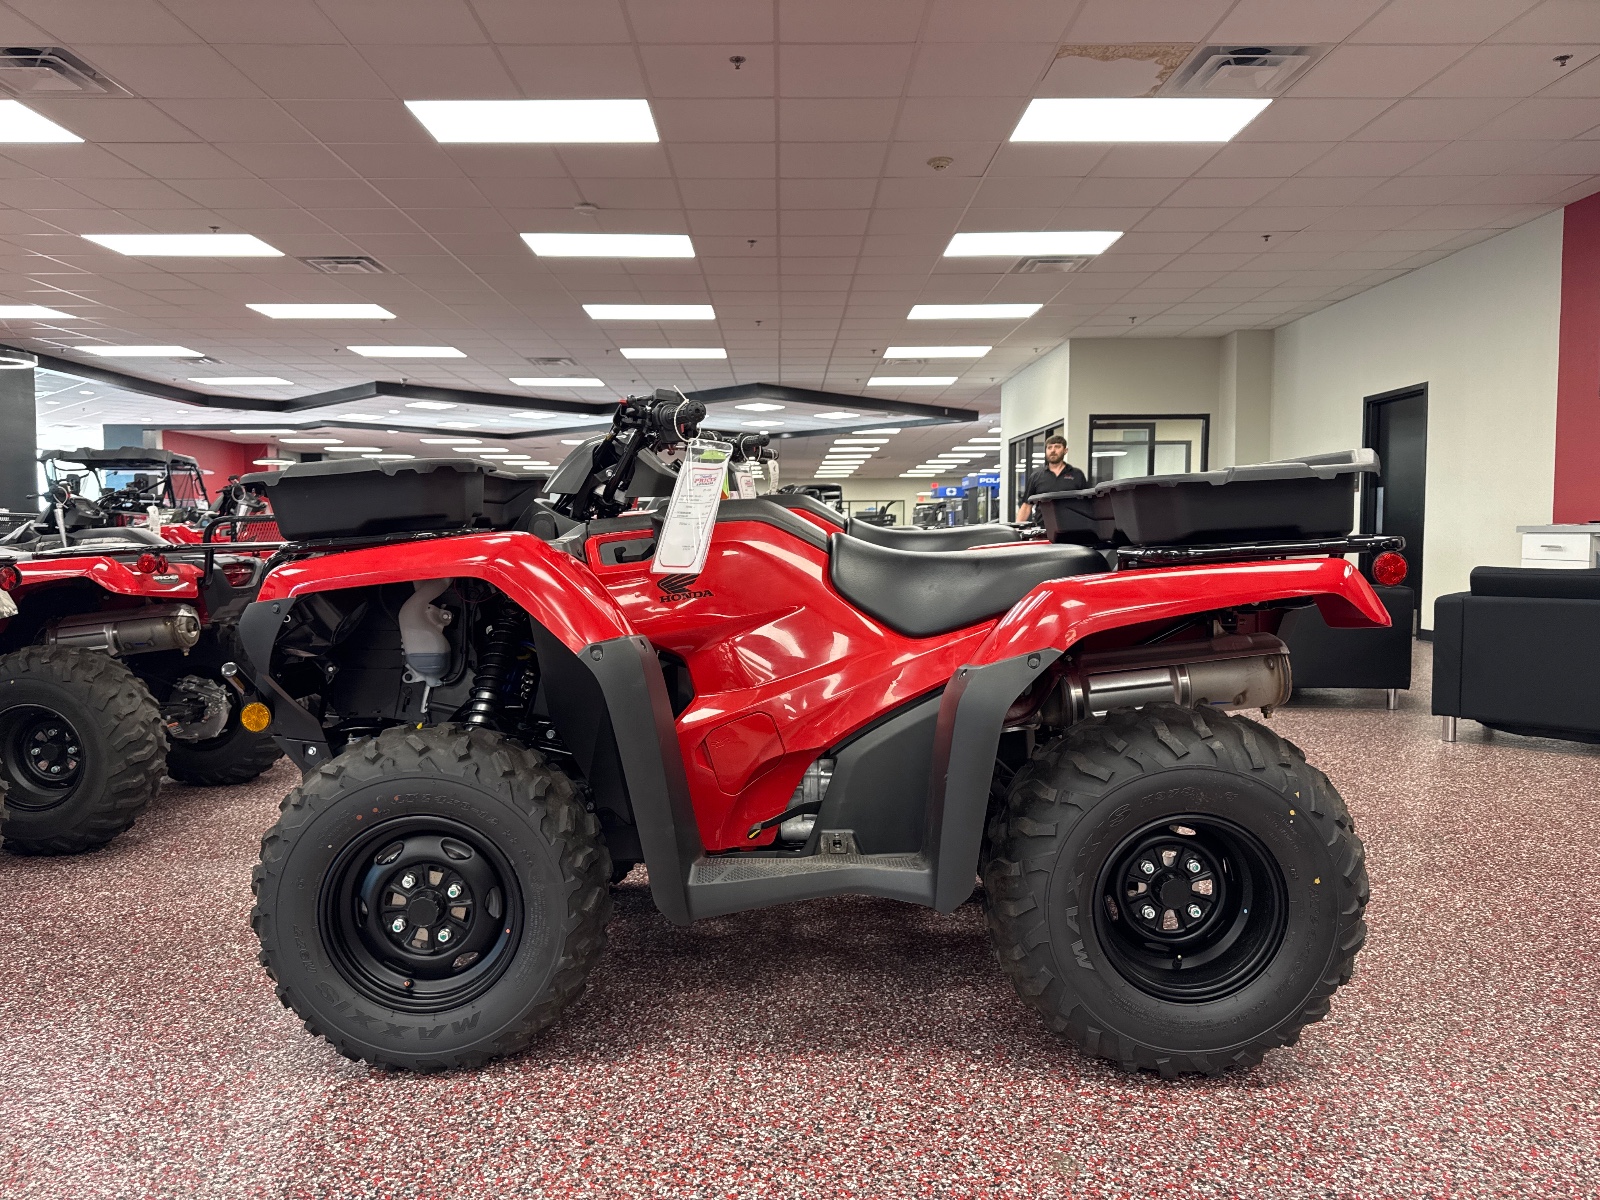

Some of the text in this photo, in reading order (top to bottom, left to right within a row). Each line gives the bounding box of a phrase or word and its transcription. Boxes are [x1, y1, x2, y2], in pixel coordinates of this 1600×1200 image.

[659, 589, 715, 603] HONDA
[1065, 801, 1134, 973] MAXXIS
[312, 980, 483, 1041] MAXXIS
